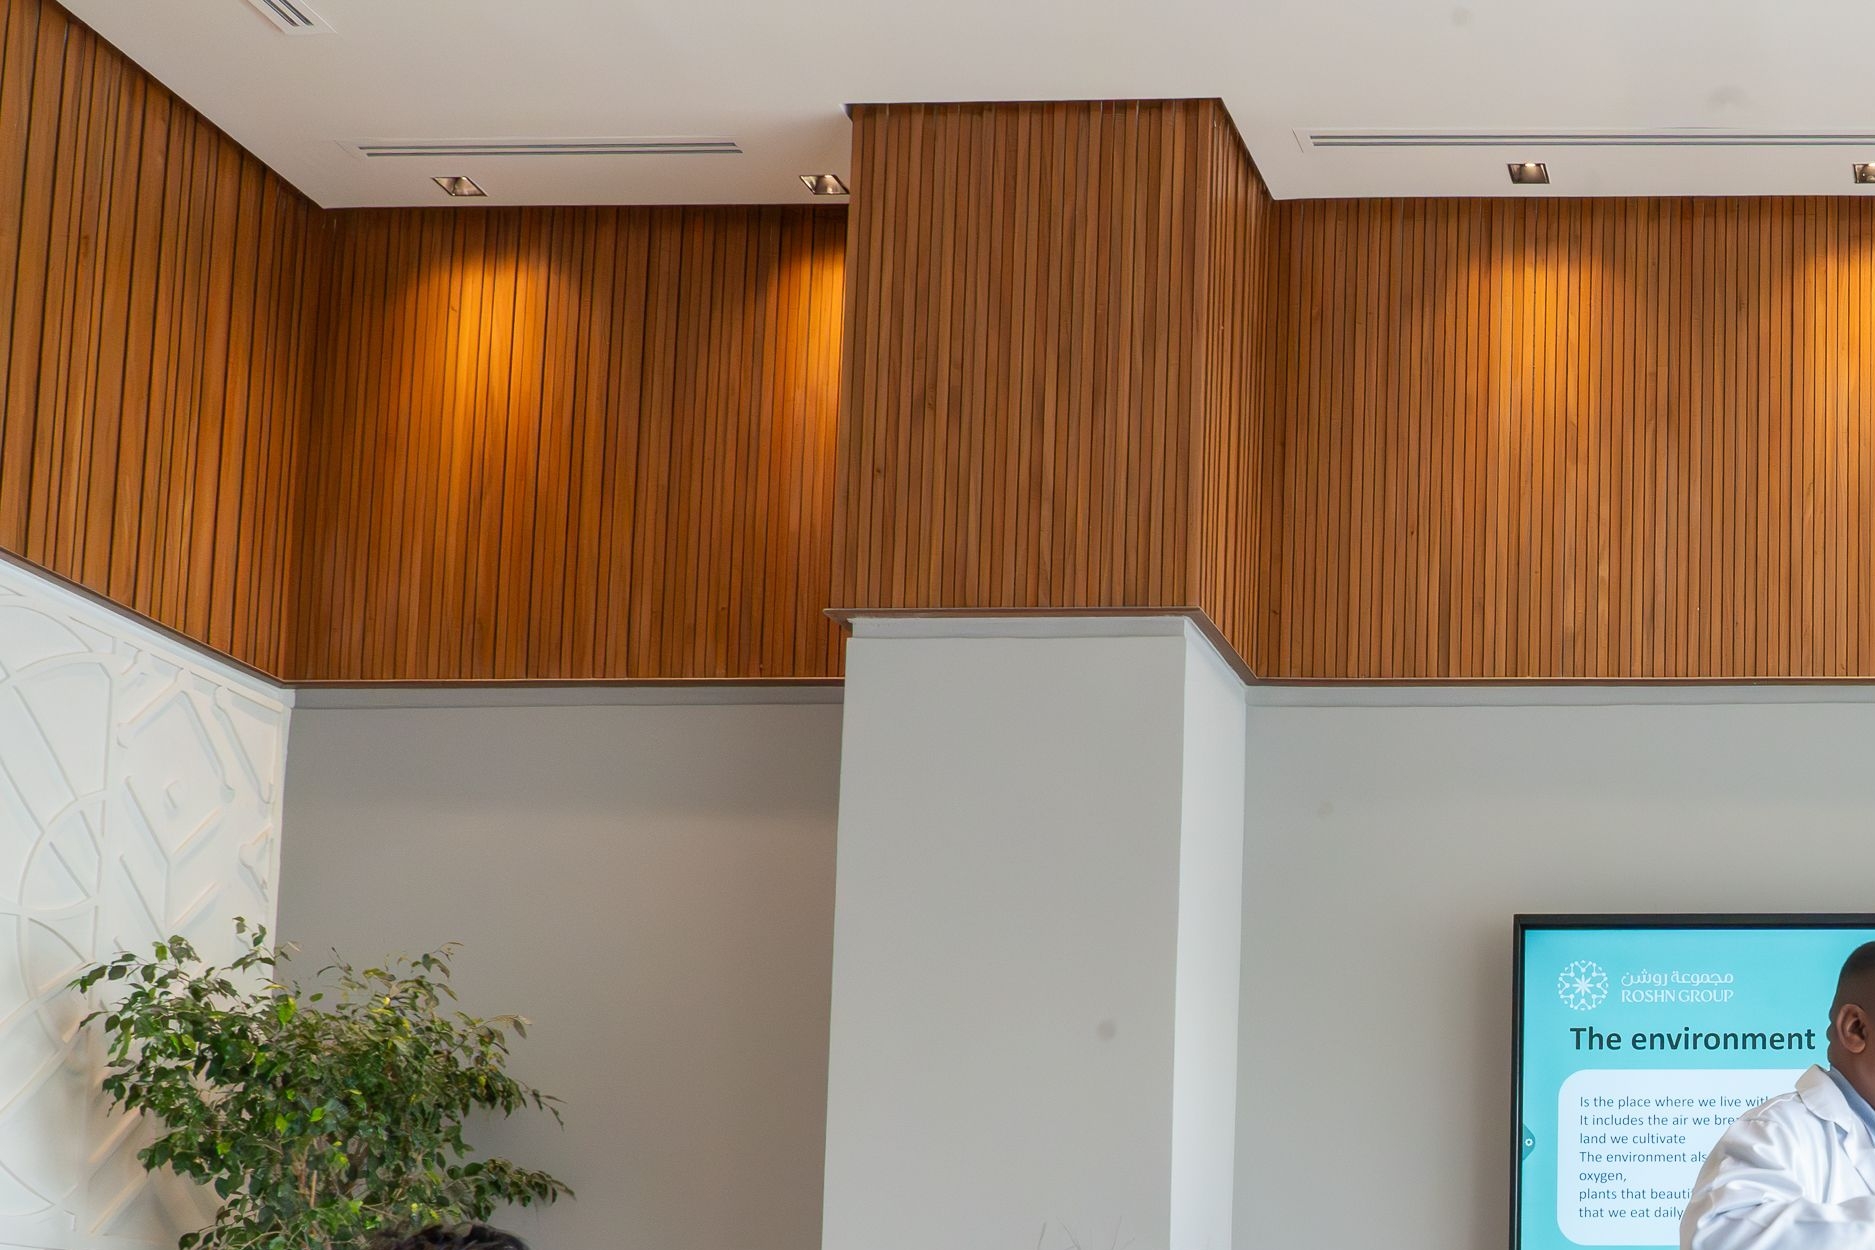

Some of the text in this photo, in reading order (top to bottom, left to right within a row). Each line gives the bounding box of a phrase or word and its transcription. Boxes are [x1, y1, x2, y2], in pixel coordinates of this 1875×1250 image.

[1621, 968, 1734, 987] مجموعة روشن
[1621, 989, 1735, 1003] ROSHN GROUP
[1569, 1025, 1816, 1051] The environment
[1580, 1096, 1590, 1108] Is
[1593, 1095, 1614, 1108] the
[1617, 1095, 1651, 1110] place
[1654, 1095, 1695, 1108] where
[1698, 1098, 1717, 1108] we
[1720, 1095, 1742, 1108] live
[1580, 1114, 1739, 1126] It includes the air we bre
[1579, 1132, 1686, 1145] land we cultivate
[1578, 1151, 1603, 1163] The
[1606, 1151, 1687, 1163] environment
[1690, 1152, 1707, 1162] als
[1579, 1170, 1627, 1183] oxygen,
[1579, 1187, 1693, 1201] plants that beauti
[1578, 1206, 1684, 1221] that we eat daily
